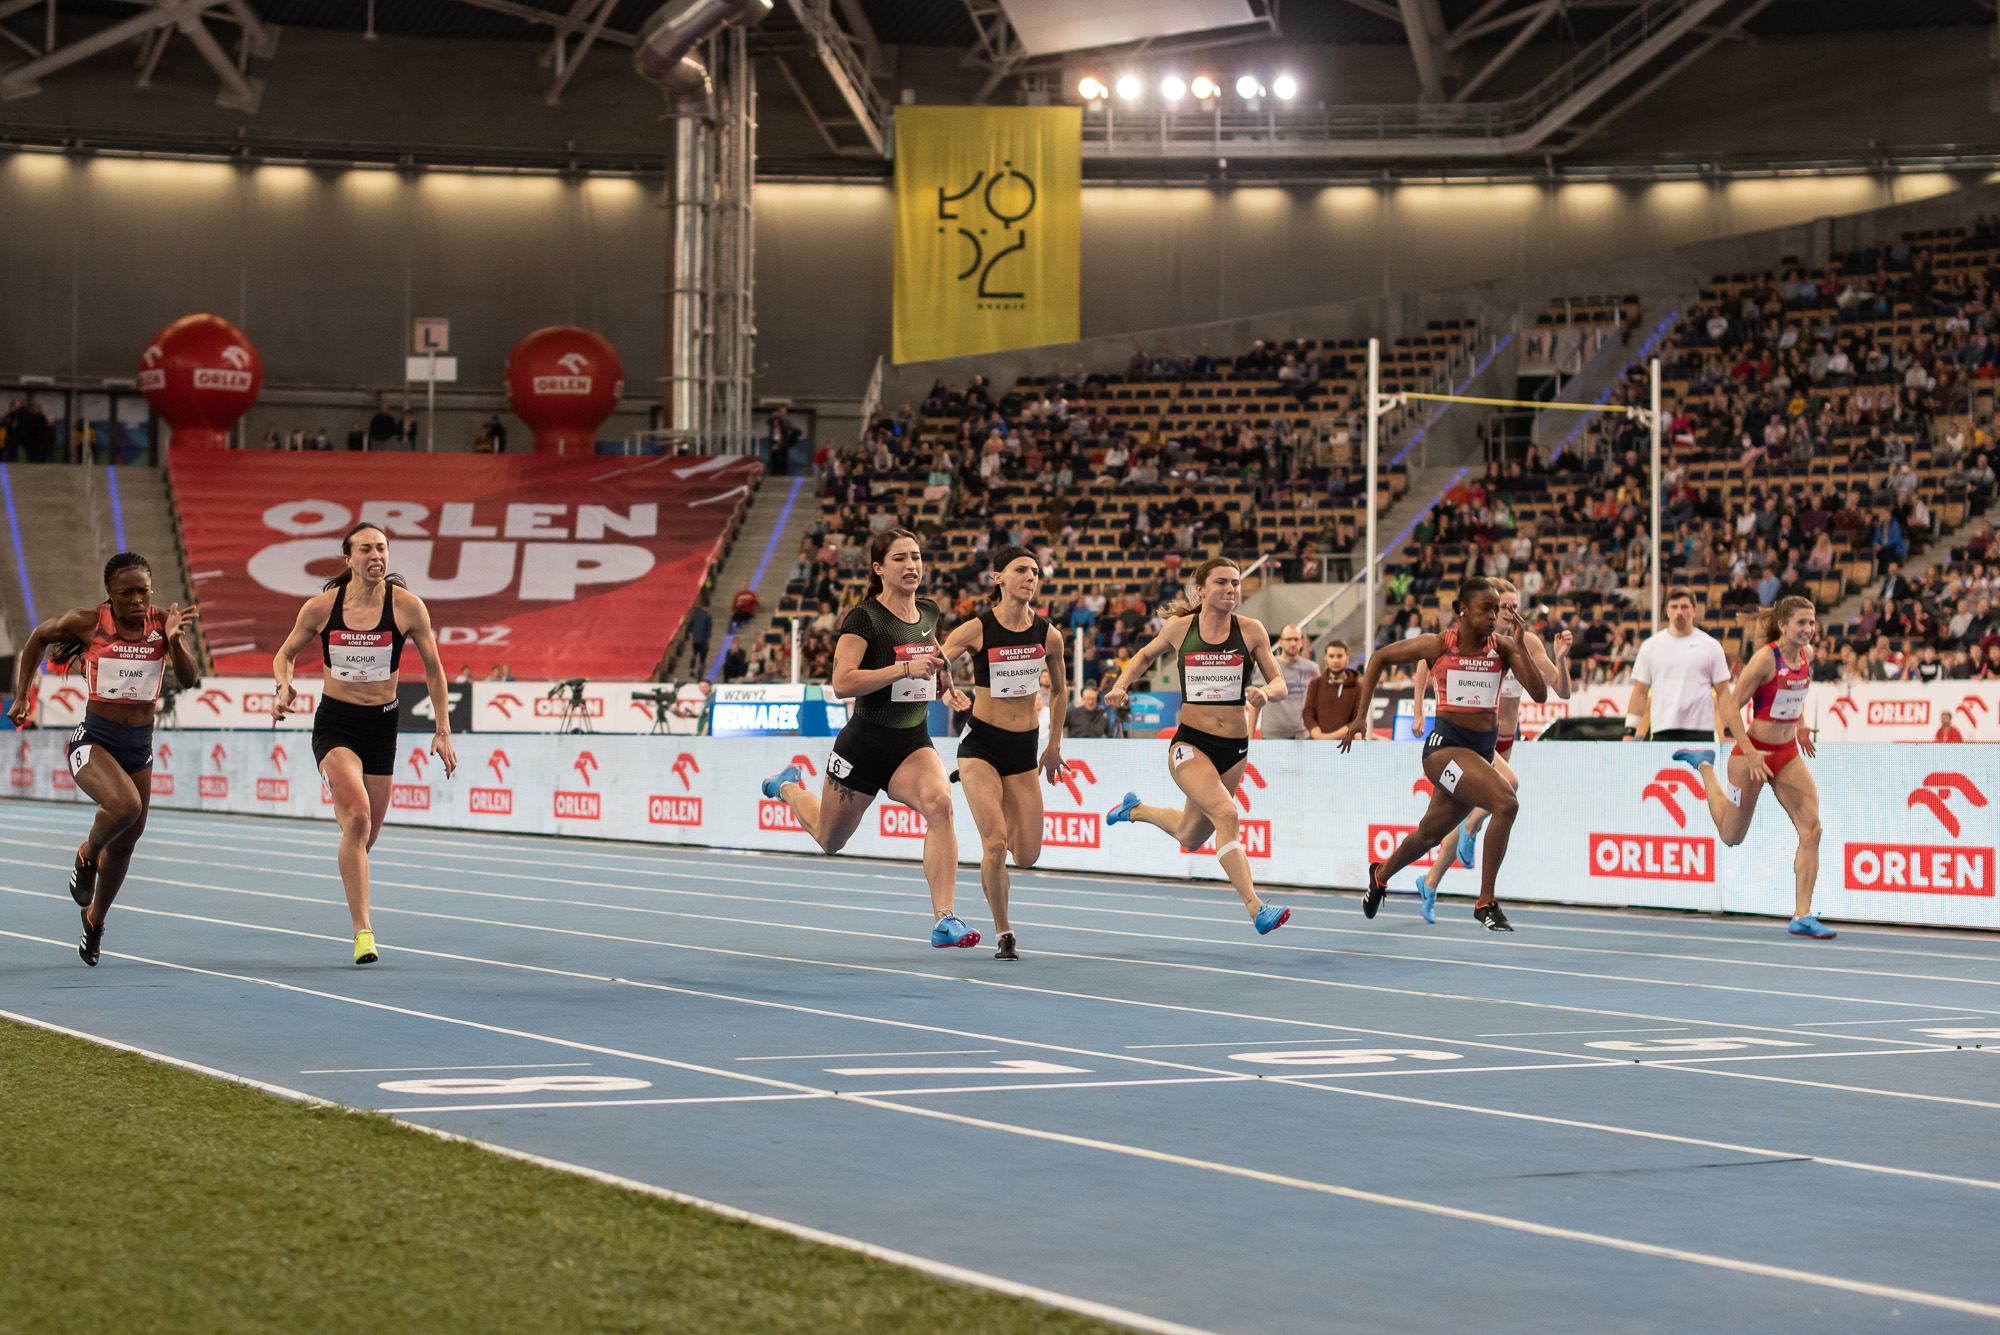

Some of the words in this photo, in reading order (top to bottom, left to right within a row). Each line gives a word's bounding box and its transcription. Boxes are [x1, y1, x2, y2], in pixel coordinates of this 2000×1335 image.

[425, 327, 440, 347] L
[199, 373, 249, 387] ORLEN
[537, 380, 587, 391] ORLEN
[262, 500, 658, 539] ORLEN
[247, 538, 656, 601] CUP
[112, 645, 139, 654] ORLEN
[139, 646, 154, 655] CUP
[906, 645, 925, 654] ORLEN
[925, 645, 935, 653] CUP
[999, 648, 1023, 656] ORLEN
[1482, 660, 1495, 668] CUP
[119, 670, 143, 678] EVANS
[1458, 680, 1492, 688] BURCHELL
[1870, 703, 1927, 722] ORLEN
[75, 750, 82, 768] 8
[1175, 747, 1184, 760] 4
[1444, 769, 1456, 783] 3
[259, 782, 287, 798] ORLEN
[393, 788, 428, 806] ORLEN
[472, 792, 510, 812] ORLEN
[556, 795, 598, 816] ORLEN
[652, 799, 698, 822] ORLEN
[762, 804, 797, 828] ORL
[884, 811, 928, 834] ORLE
[1044, 815, 1096, 845] RLEN
[1596, 839, 1706, 877] ORLEN
[1852, 850, 1984, 890] ORLEN
[378, 1075, 653, 1096] 8
